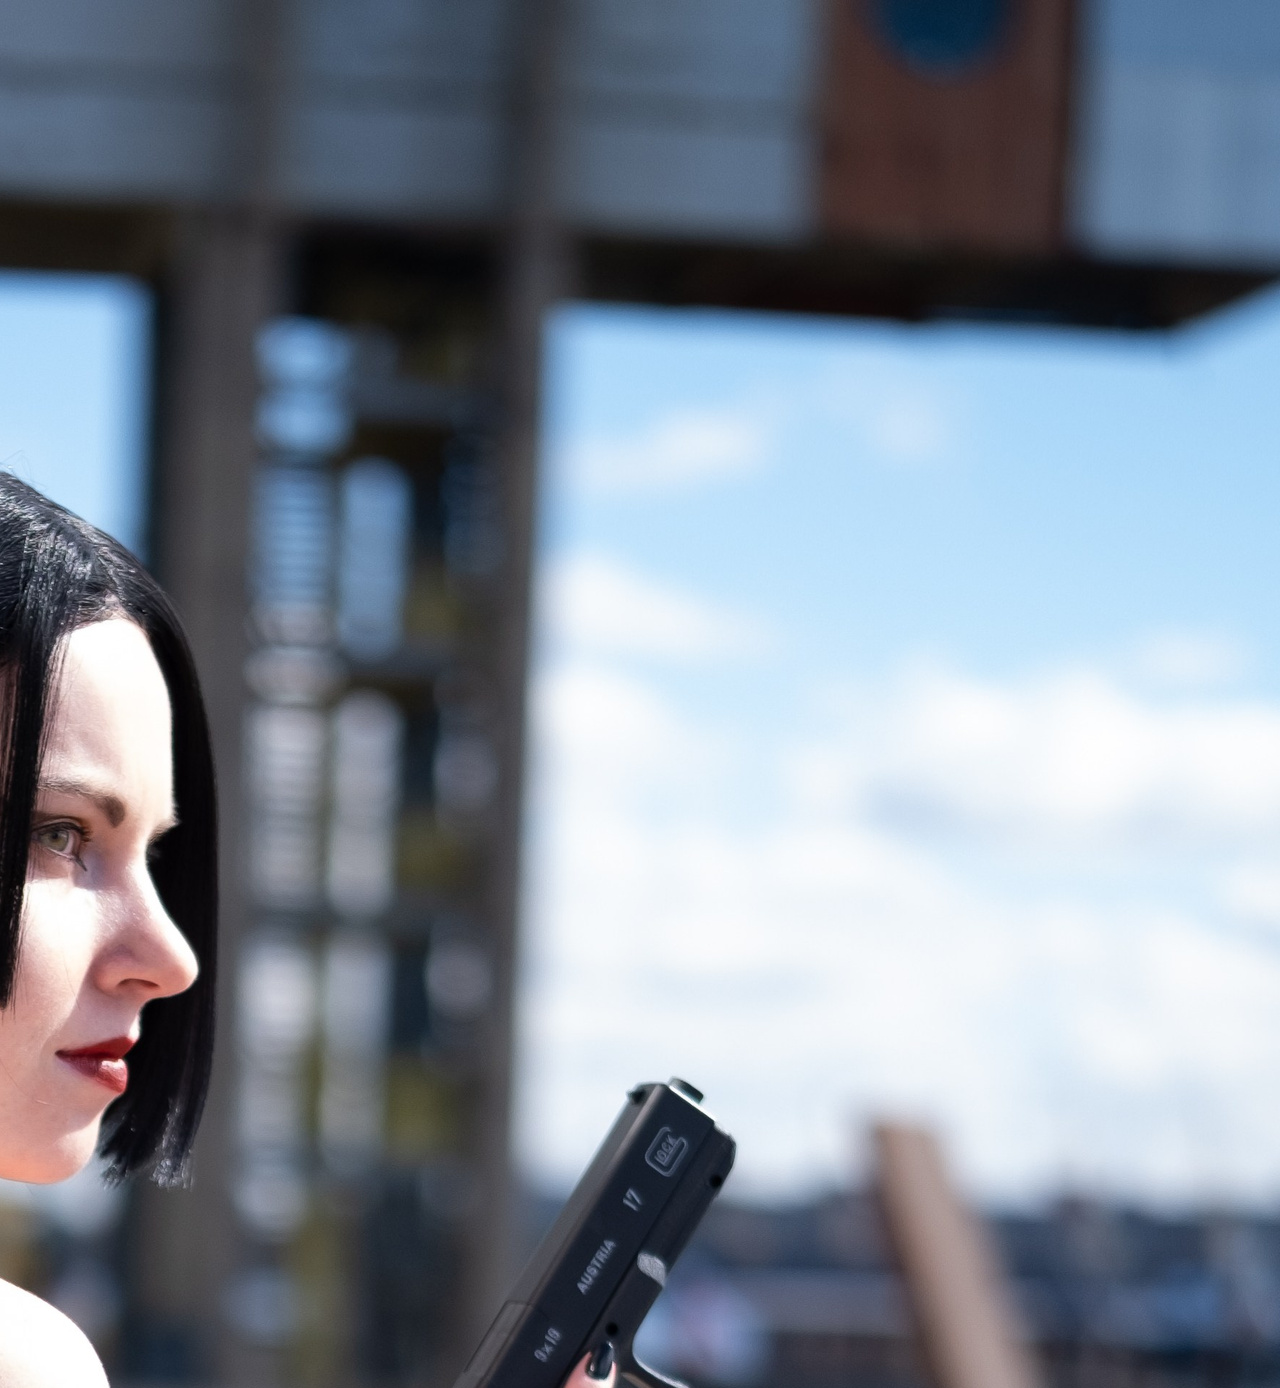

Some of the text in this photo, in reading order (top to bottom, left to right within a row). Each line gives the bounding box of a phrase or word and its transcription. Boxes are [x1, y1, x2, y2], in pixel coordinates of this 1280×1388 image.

[577, 1239, 616, 1295] AUSTRIA
[622, 1188, 642, 1211] 17
[645, 1126, 688, 1177] GLOCK
